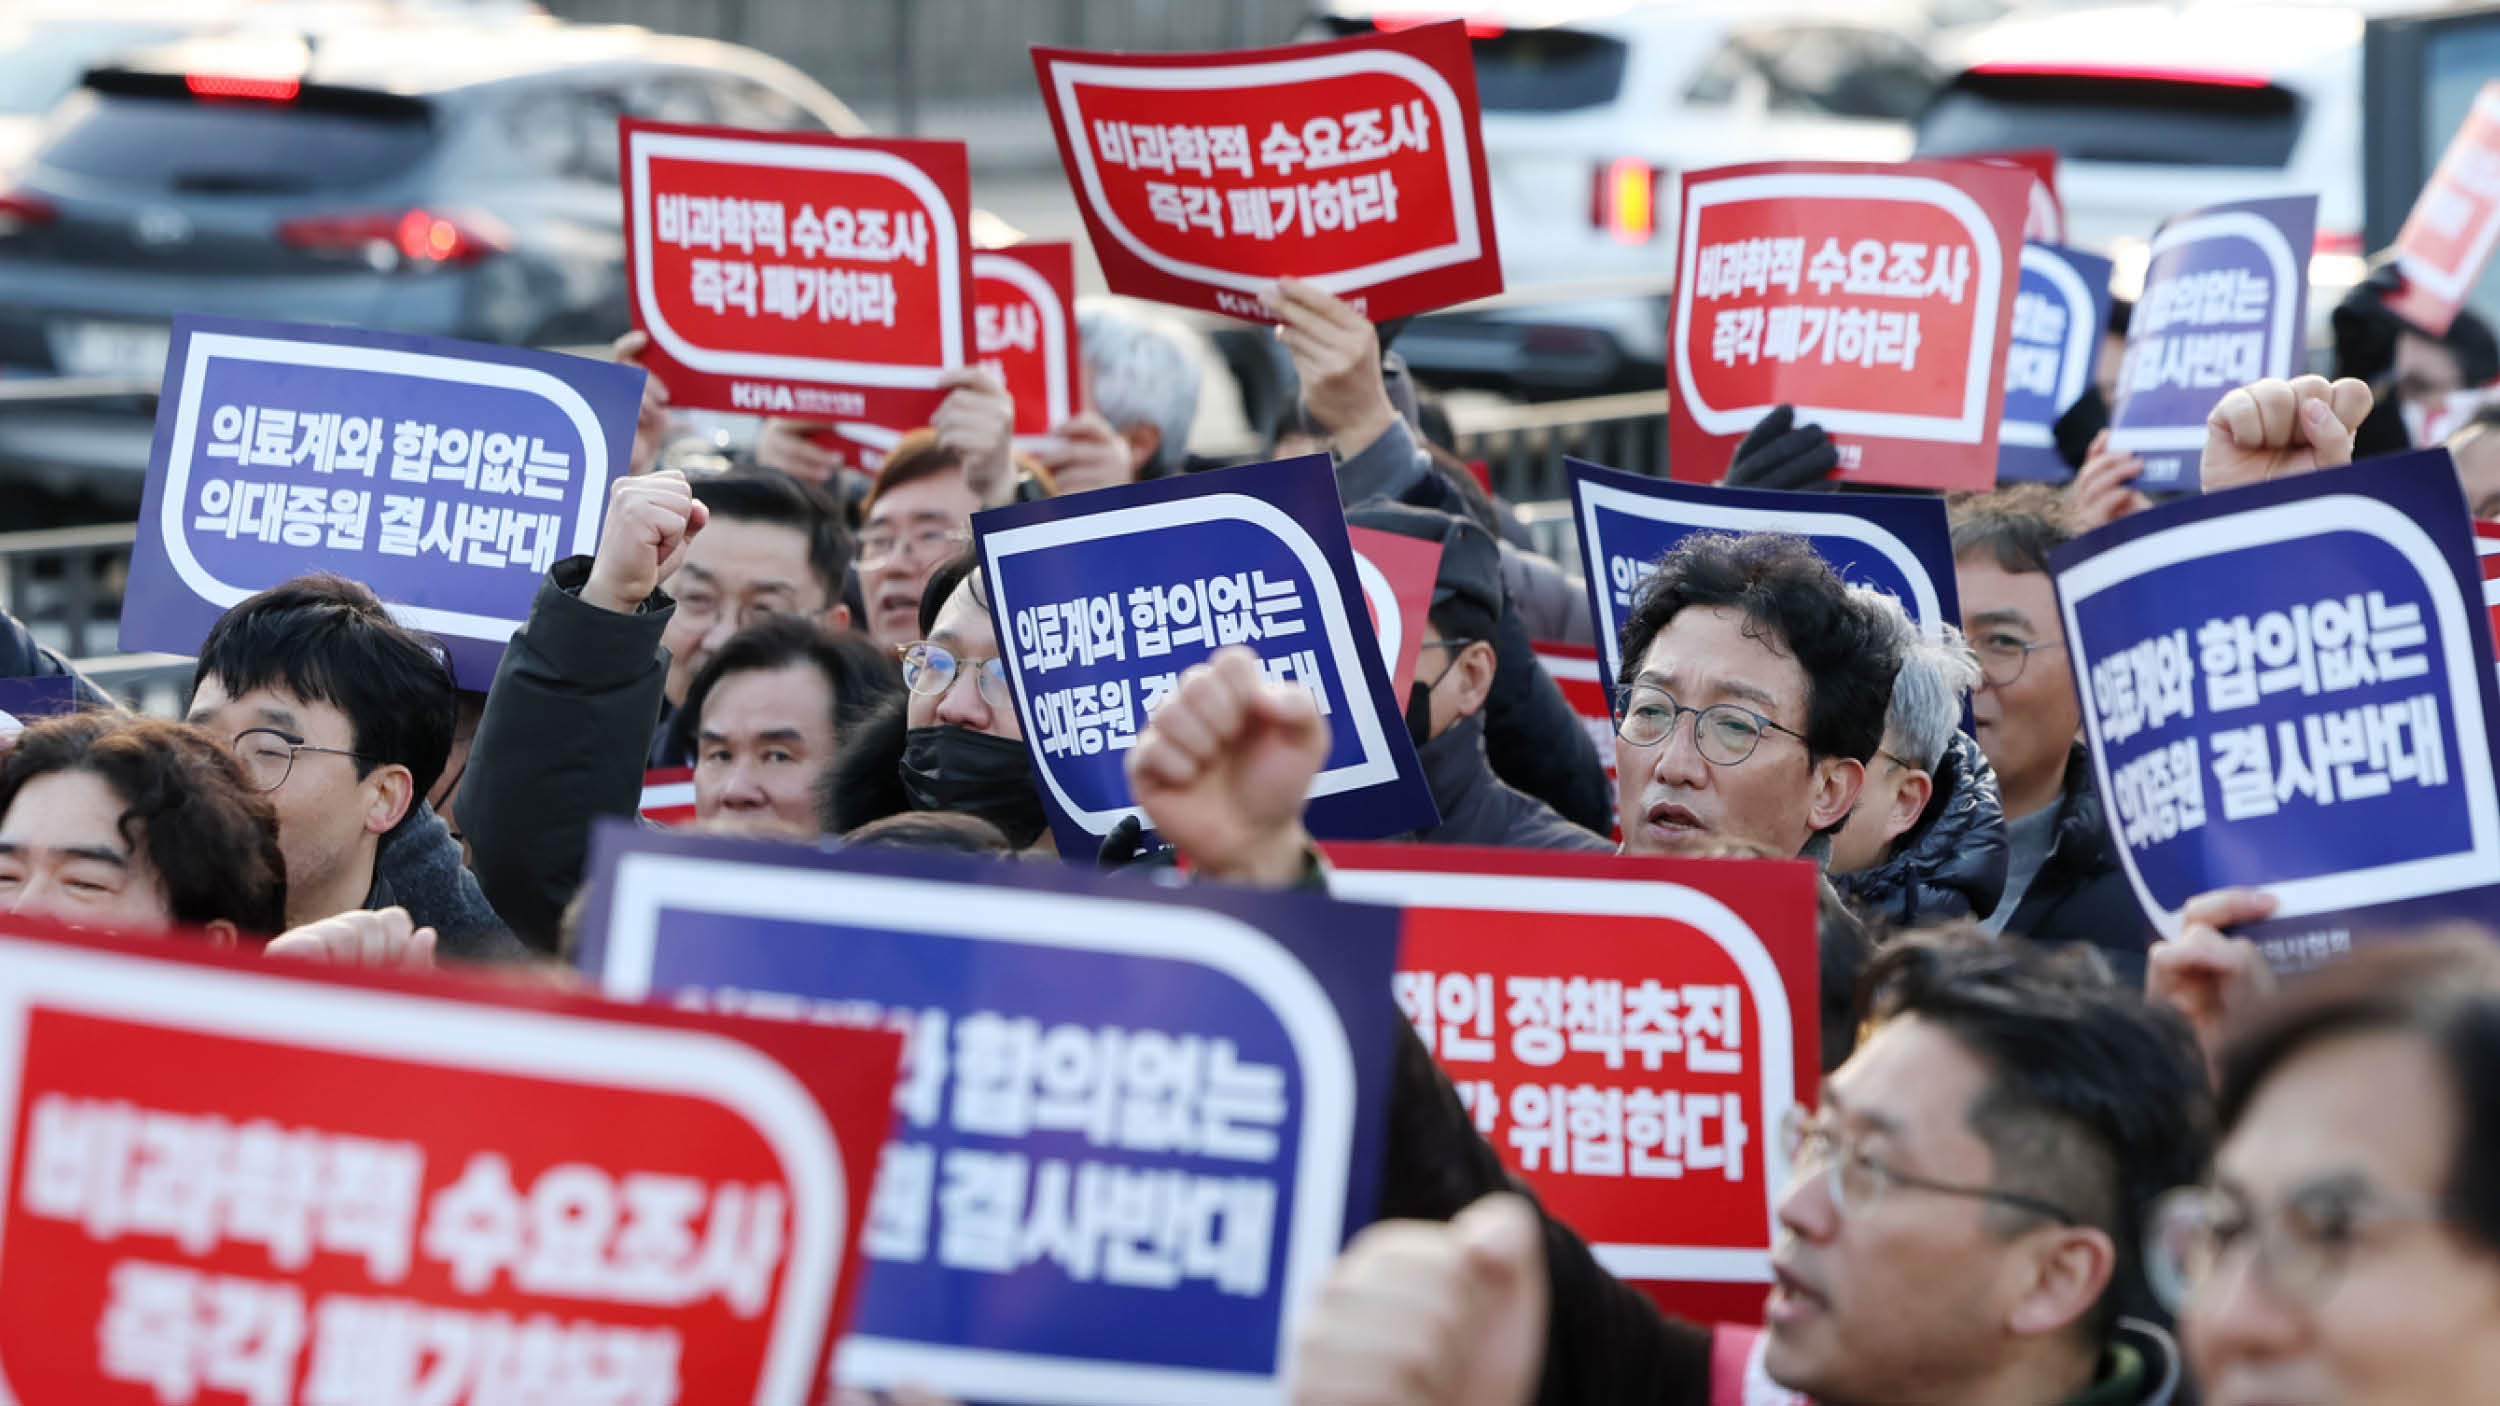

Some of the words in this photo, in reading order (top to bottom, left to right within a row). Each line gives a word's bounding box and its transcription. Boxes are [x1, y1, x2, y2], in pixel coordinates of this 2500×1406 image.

[1094, 119, 1253, 178] 비과학적
[1260, 100, 1430, 176] 수요조사
[657, 194, 786, 256] 비과학적
[791, 205, 928, 266] 수요조사
[1145, 180, 1225, 239] 즉각
[1228, 170, 1399, 240] 폐기하라
[691, 258, 758, 317] 즉각
[762, 266, 896, 327] 폐기하라
[1697, 237, 1805, 300] 비과학적
[1808, 237, 1970, 304] 수요조사
[1712, 306, 1763, 368] 즉각
[1763, 306, 1921, 370] 폐기하라
[207, 405, 384, 477] 의료계와
[390, 420, 570, 501] 합의없는
[195, 479, 372, 551] 의대증원
[378, 494, 561, 574] 결사반대
[1016, 592, 1127, 675] 의료계와
[1128, 570, 1306, 659] 합의없는
[2093, 629, 2196, 744] 의료계와
[2197, 591, 2429, 712] 합의없는
[1033, 678, 1138, 759] 의대증원
[2210, 694, 2448, 822] 결사반대
[1506, 974, 1742, 1074] 정책추진
[951, 1013, 1287, 1164] 합의없는
[1507, 1083, 1748, 1181] 위협한다
[21, 1091, 426, 1284] 비과학적
[422, 1151, 786, 1320] 수요조사
[939, 1144, 1277, 1297] 결사반대
[98, 1258, 308, 1406] 즉각
